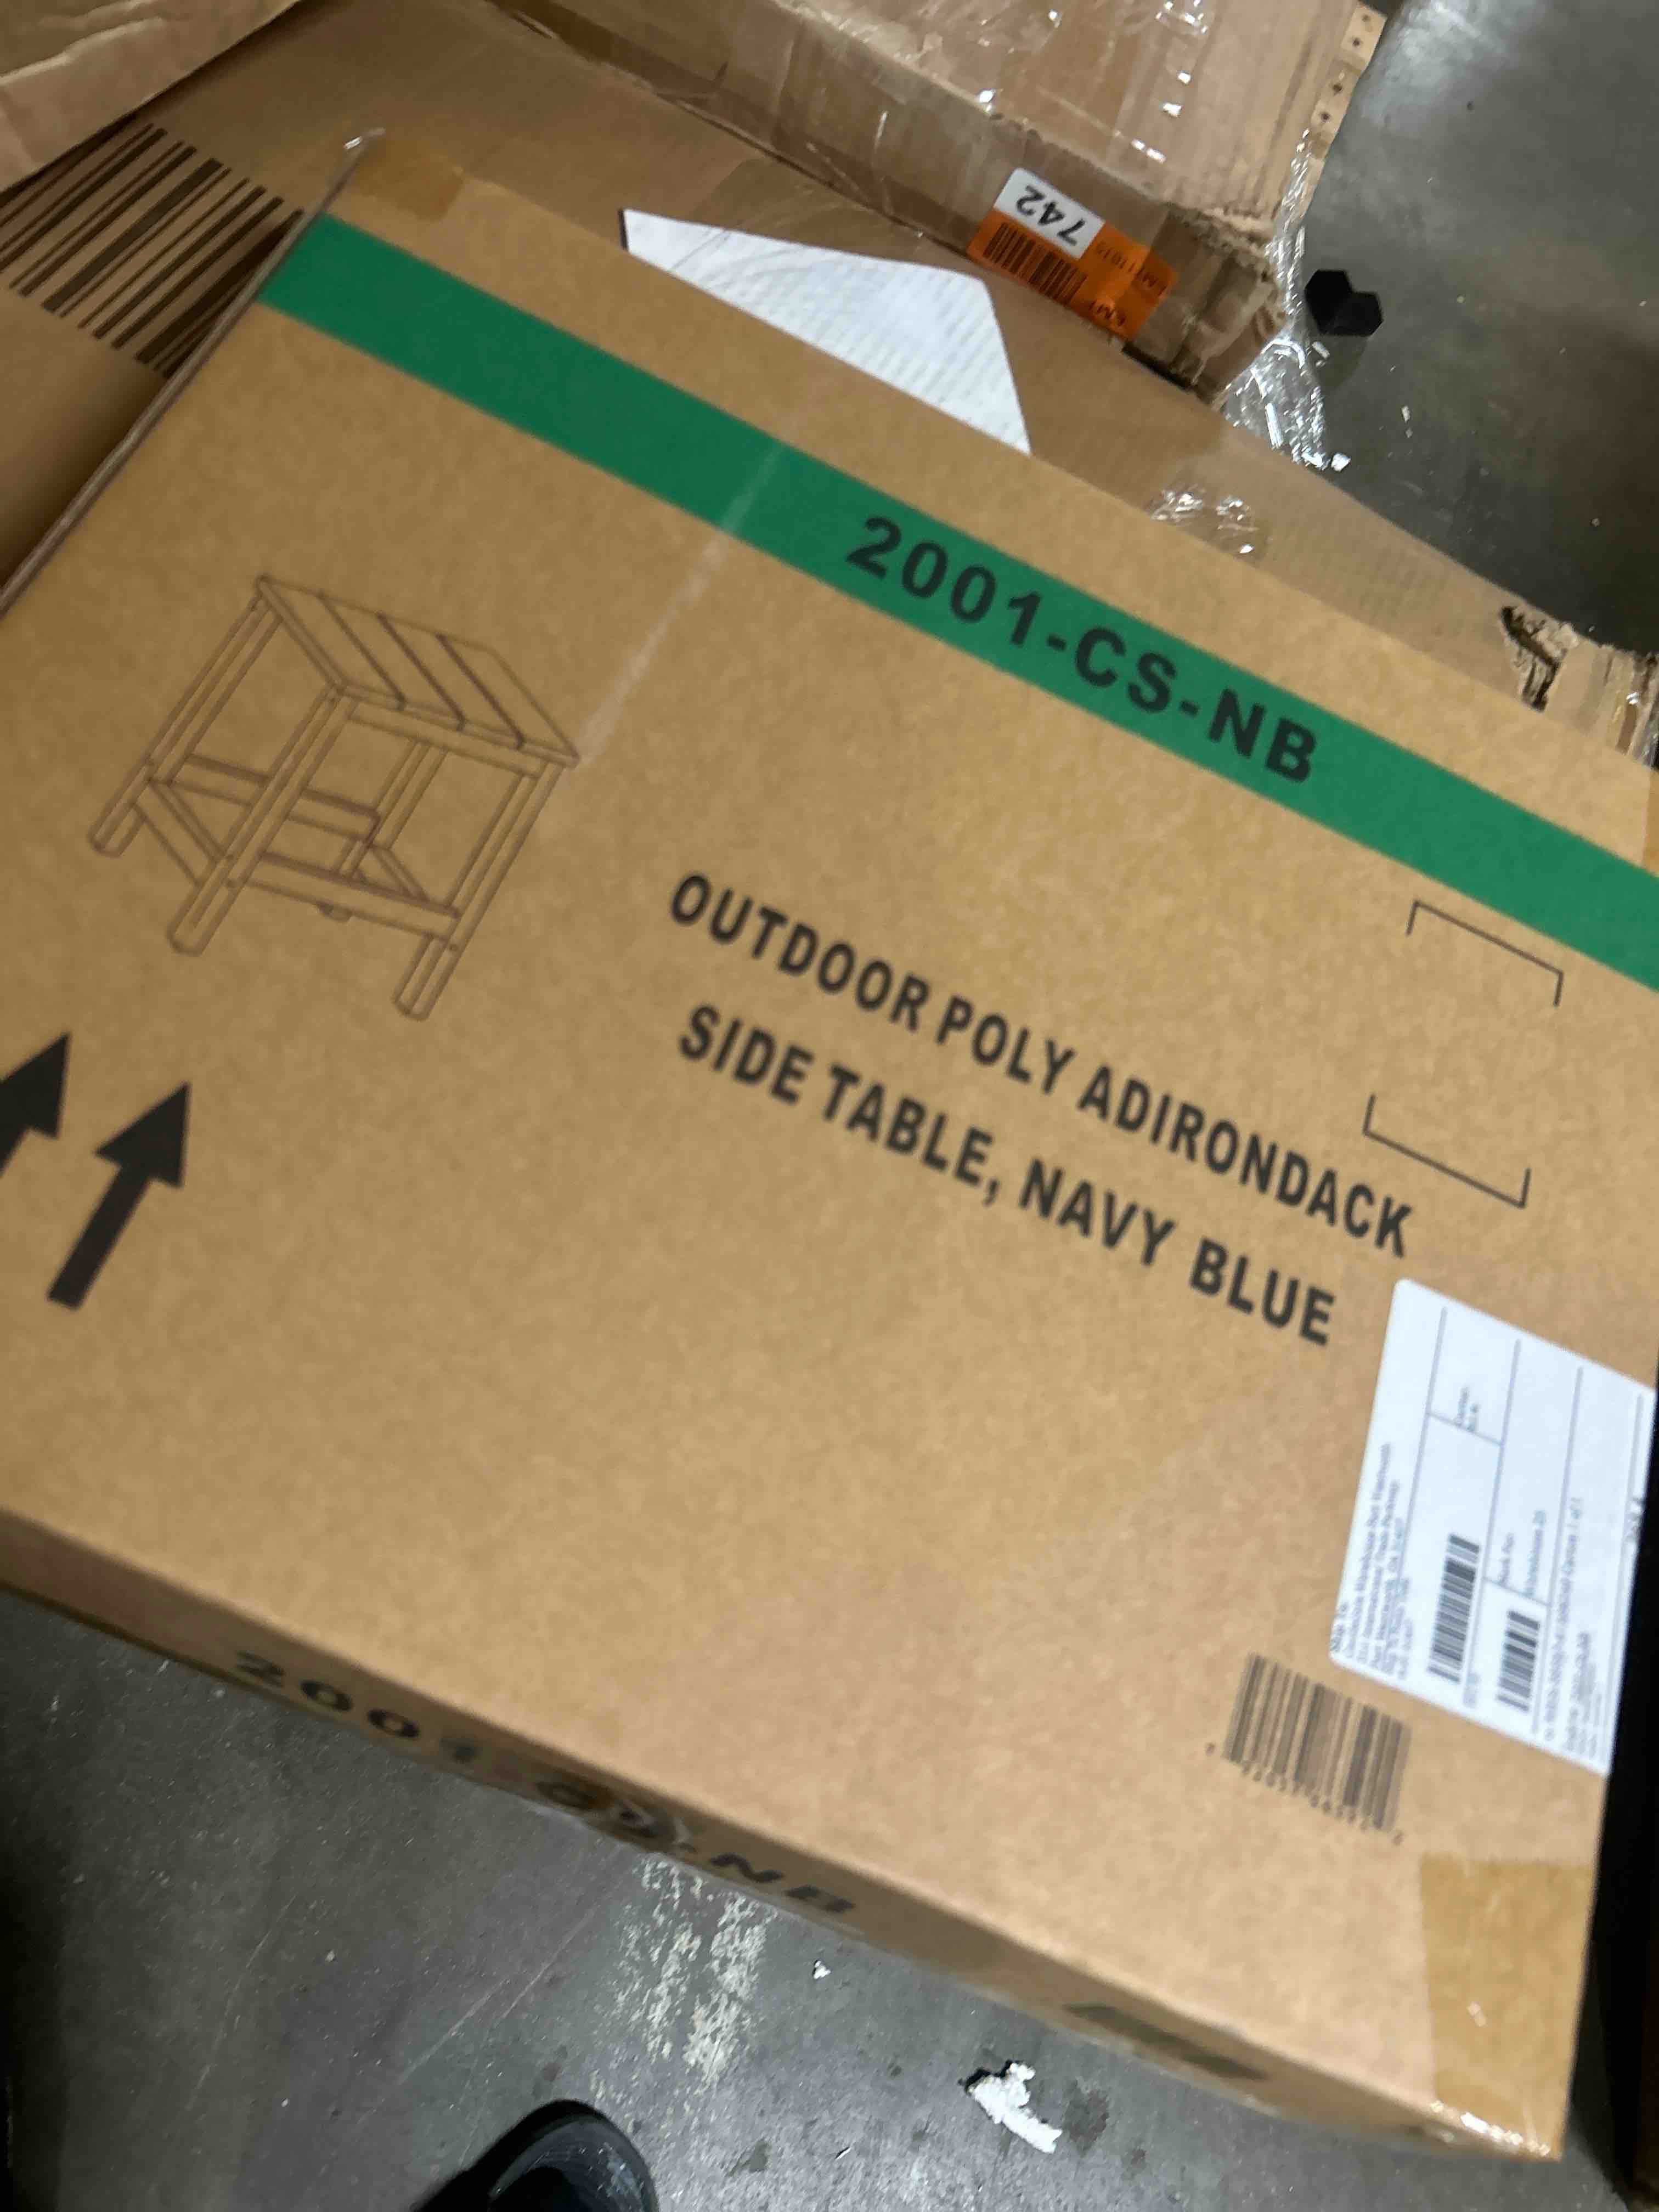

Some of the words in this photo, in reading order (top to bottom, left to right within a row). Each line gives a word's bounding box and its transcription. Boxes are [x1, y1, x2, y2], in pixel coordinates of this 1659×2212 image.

[1016, 184, 1086, 246] 742
[845, 516, 1317, 783] 2001-CS-NB
[669, 872, 932, 1031] OUTDOOR
[936, 996, 1075, 1093] POLY
[1077, 1065, 1413, 1258] ADIRONDACK
[679, 1005, 815, 1104] SIDE
[822, 1065, 999, 1206] TABLE,
[1019, 1158, 1175, 1266] NAVY
[1189, 1238, 1336, 1345] BLUE
